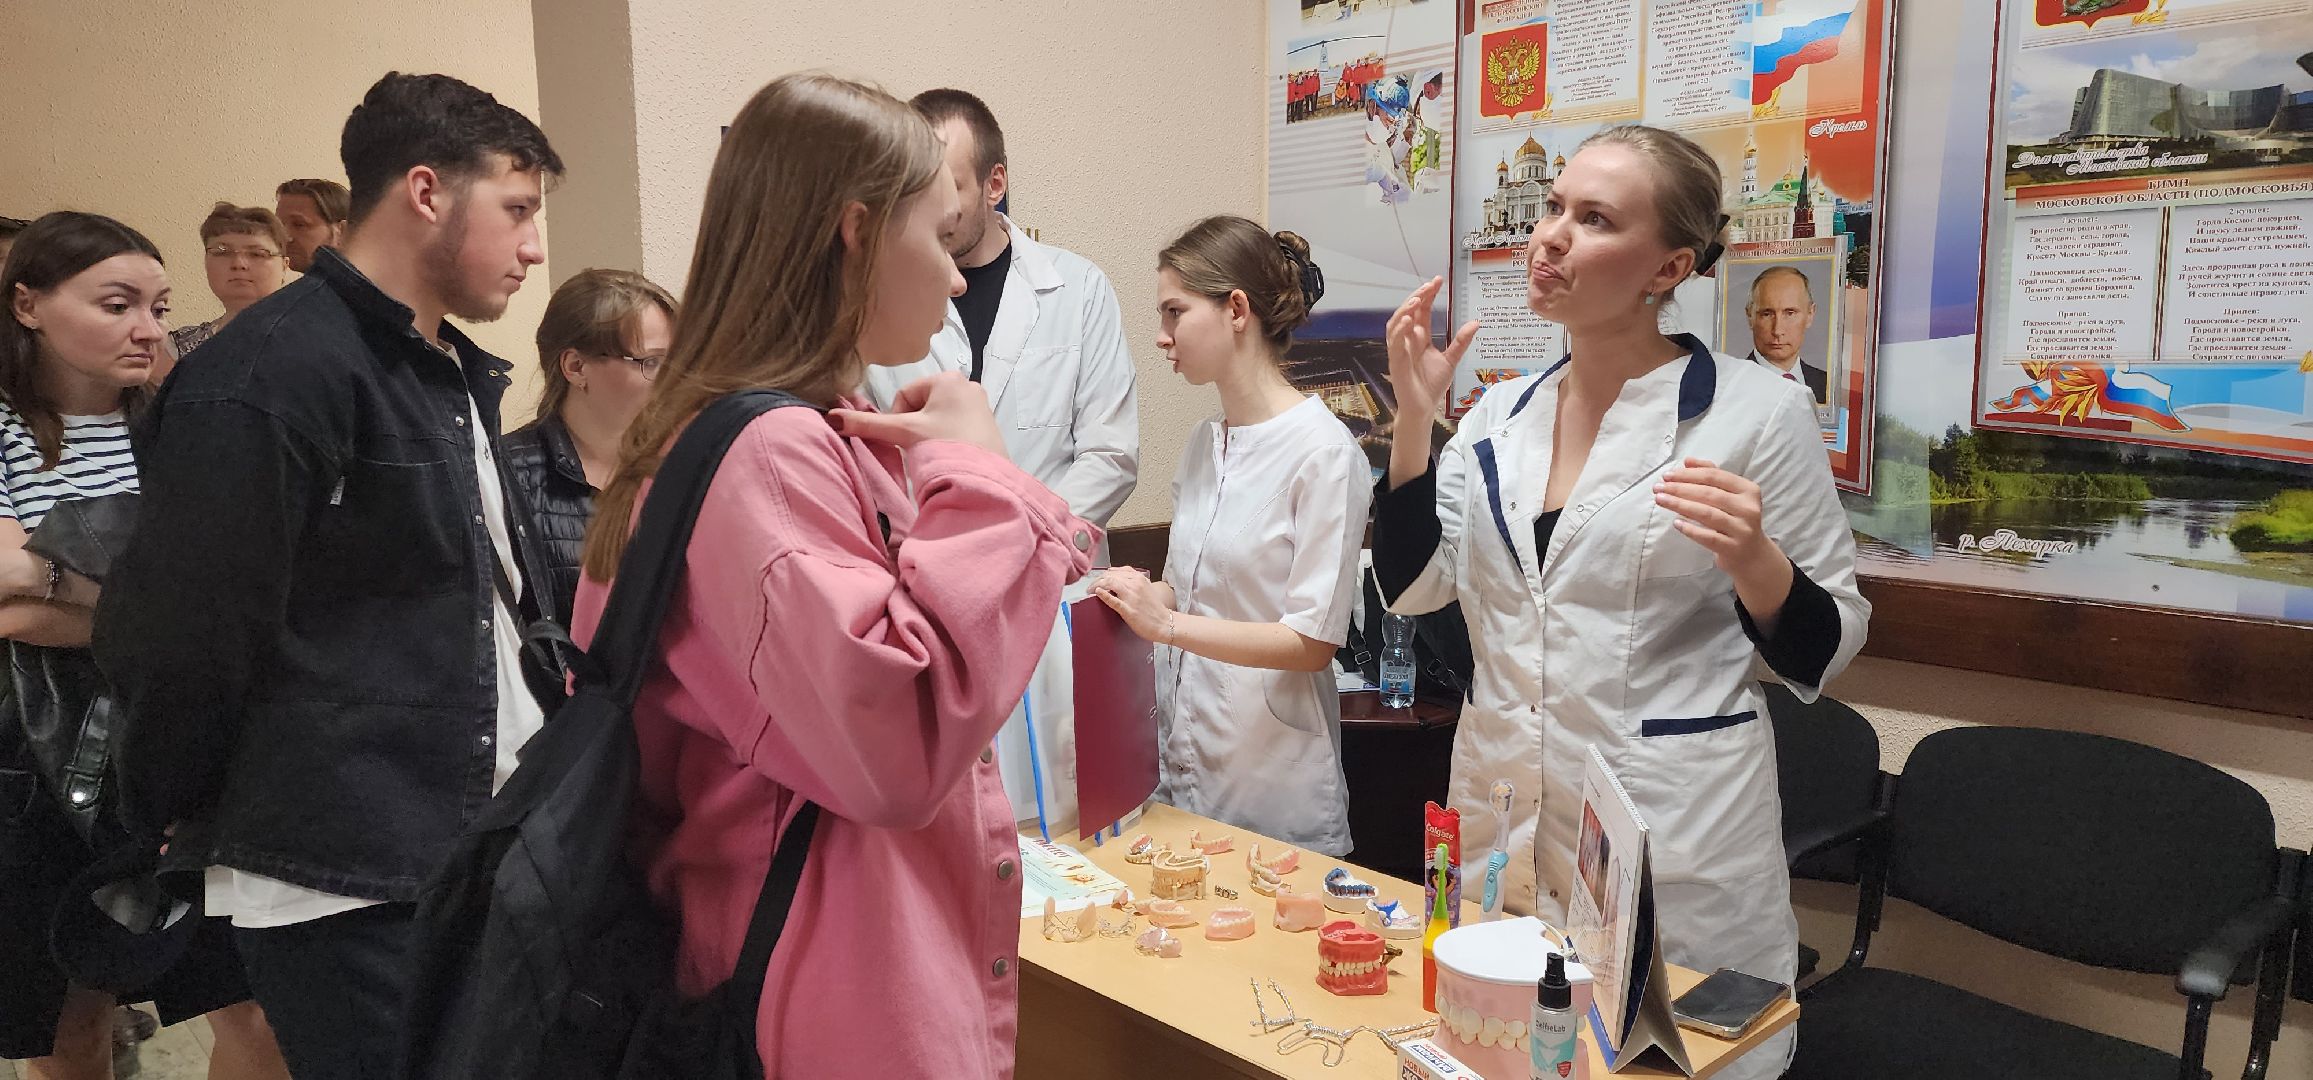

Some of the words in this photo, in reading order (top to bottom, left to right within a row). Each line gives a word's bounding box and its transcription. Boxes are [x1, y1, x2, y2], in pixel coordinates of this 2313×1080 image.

[1809, 118, 1867, 138] Кремль
[2012, 151, 2051, 169] Дом
[2052, 143, 2149, 165] правительства
[2066, 155, 2150, 176] Московской
[2152, 151, 2208, 169] области
[2147, 178, 2190, 191] ГИМН
[2035, 193, 2124, 209] МОСКОВСКОЙ
[2127, 189, 2190, 204] ОБЛАСТИ
[1958, 534, 1975, 554] р.
[1979, 528, 2077, 559] Пехорка
[1426, 823, 1455, 841] Colgate
